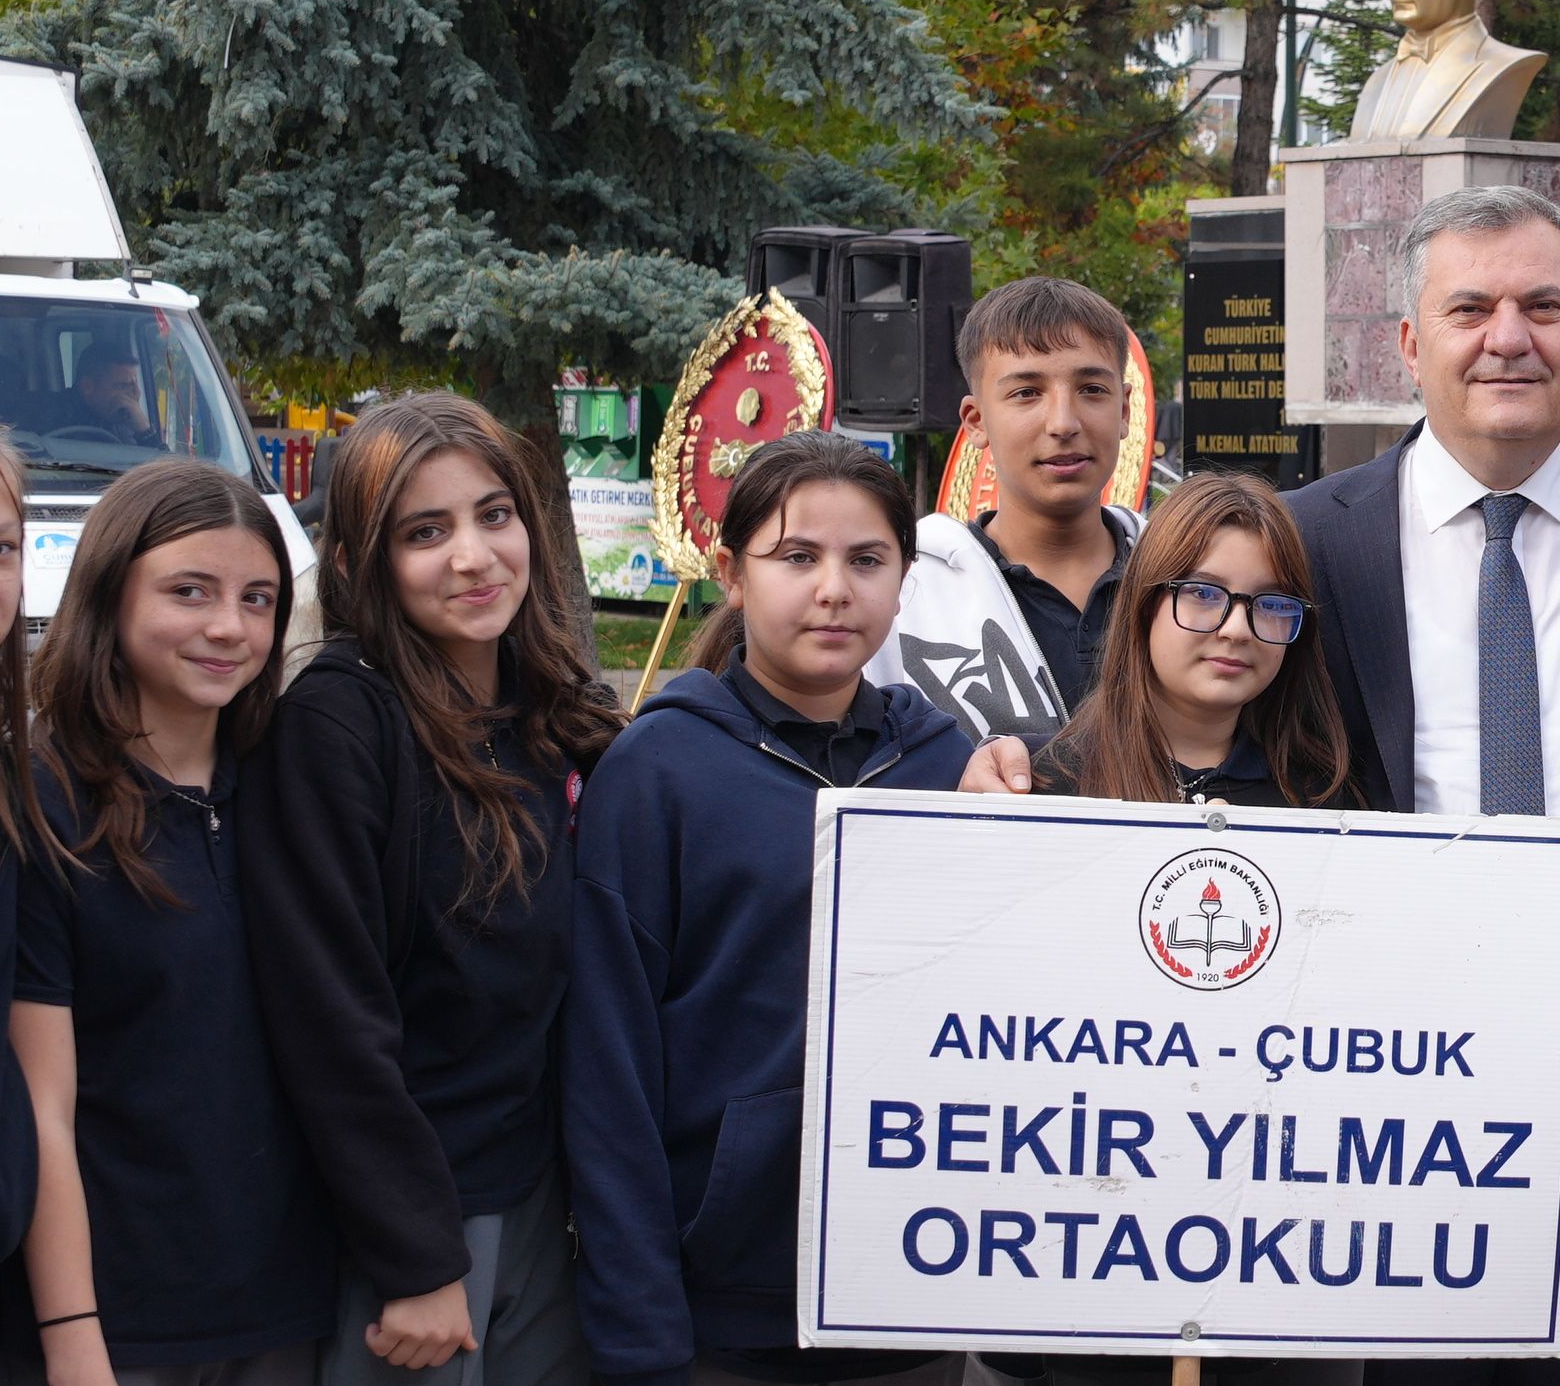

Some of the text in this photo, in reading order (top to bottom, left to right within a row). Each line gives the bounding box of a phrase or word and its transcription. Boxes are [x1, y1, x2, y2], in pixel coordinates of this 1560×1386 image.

[1224, 294, 1271, 318] TÜRKİYE
[745, 351, 770, 372] T.C.
[1188, 349, 1285, 373] KURAN TÜRK HAL
[1189, 376, 1285, 399] TÜRK MİLLETİ DE
[1196, 431, 1298, 454] M.KEMAL ATATÜRK
[627, 492, 653, 507] MERK
[1152, 857, 1270, 916] T.C. MİLLİ EĞİTİM BAKANLIĞI
[1196, 972, 1220, 983] 1920
[930, 1013, 1199, 1068] ANKARA
[1256, 1024, 1475, 1082] ÇUBUK
[868, 1091, 1533, 1189] BEKİR YILMAZ
[902, 1206, 1488, 1289] ORTAOKULU
